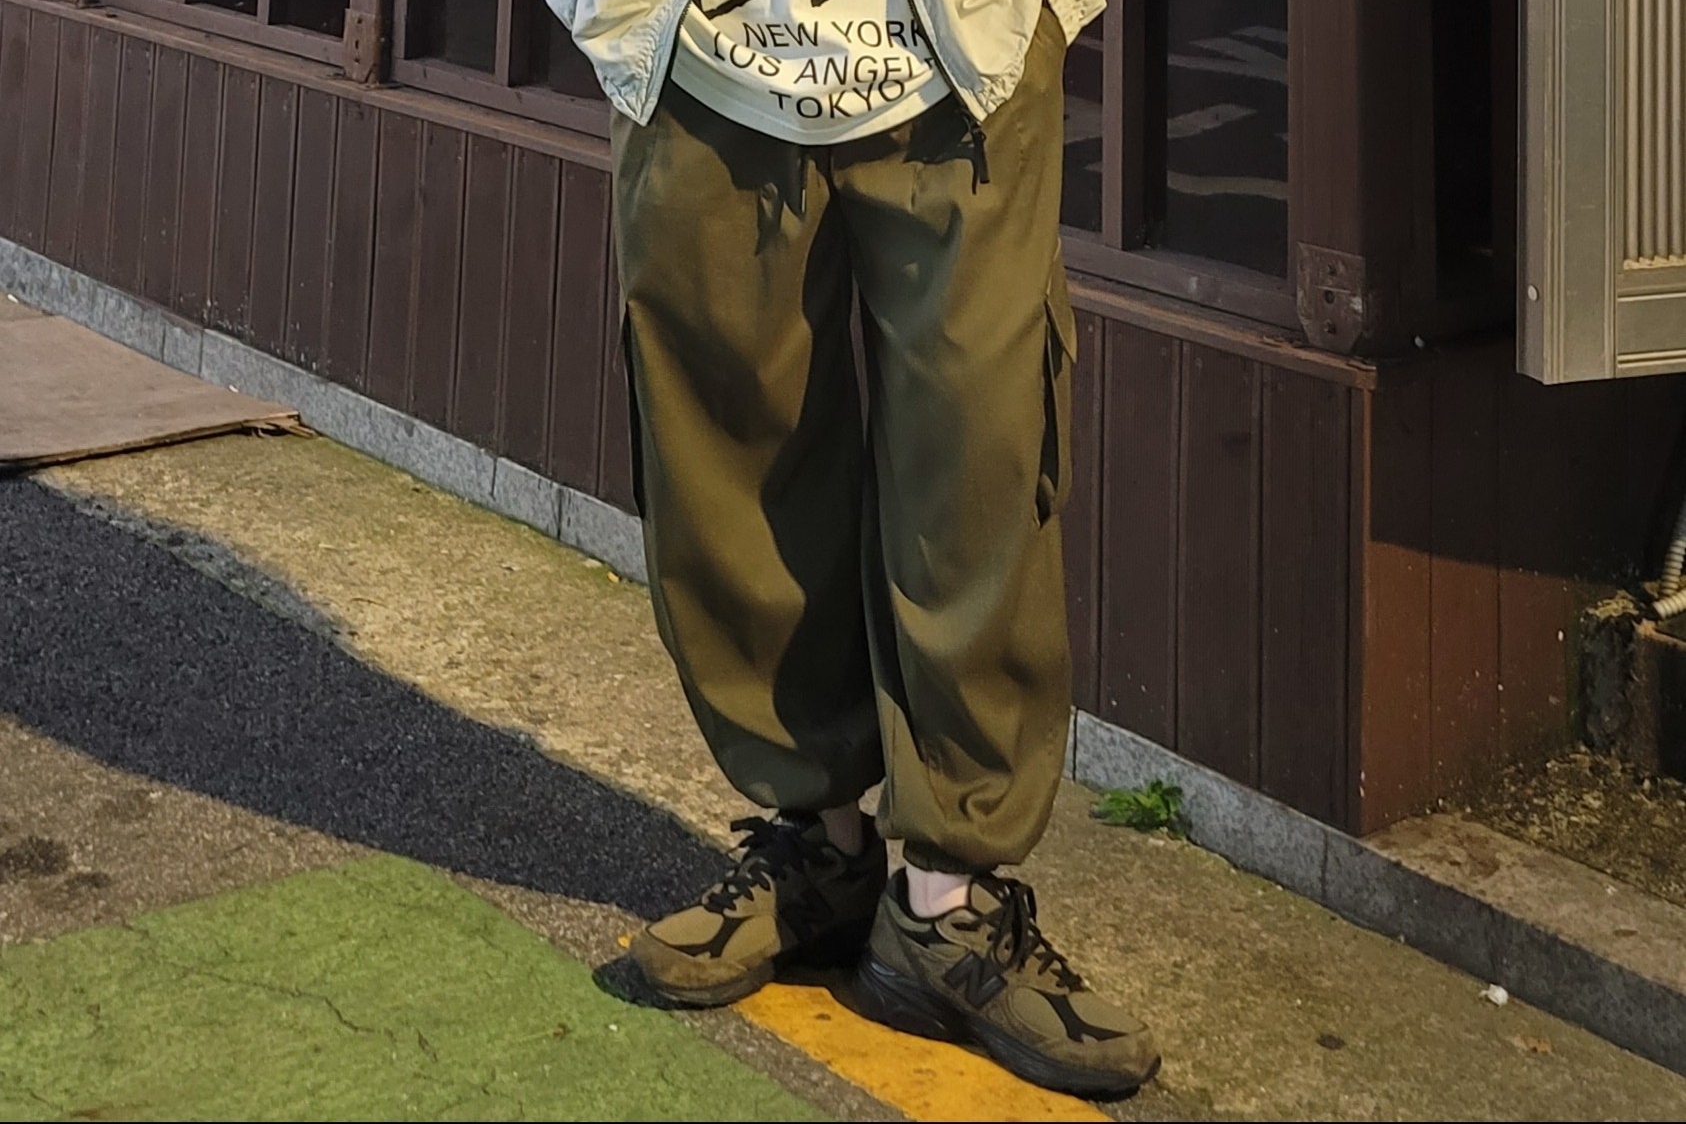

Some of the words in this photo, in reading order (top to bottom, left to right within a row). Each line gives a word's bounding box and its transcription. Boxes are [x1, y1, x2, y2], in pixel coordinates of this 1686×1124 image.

[742, 20, 819, 48] NEW
[831, 19, 925, 48] YORK
[713, 31, 782, 77] LOS
[769, 79, 905, 119] TOKYO
